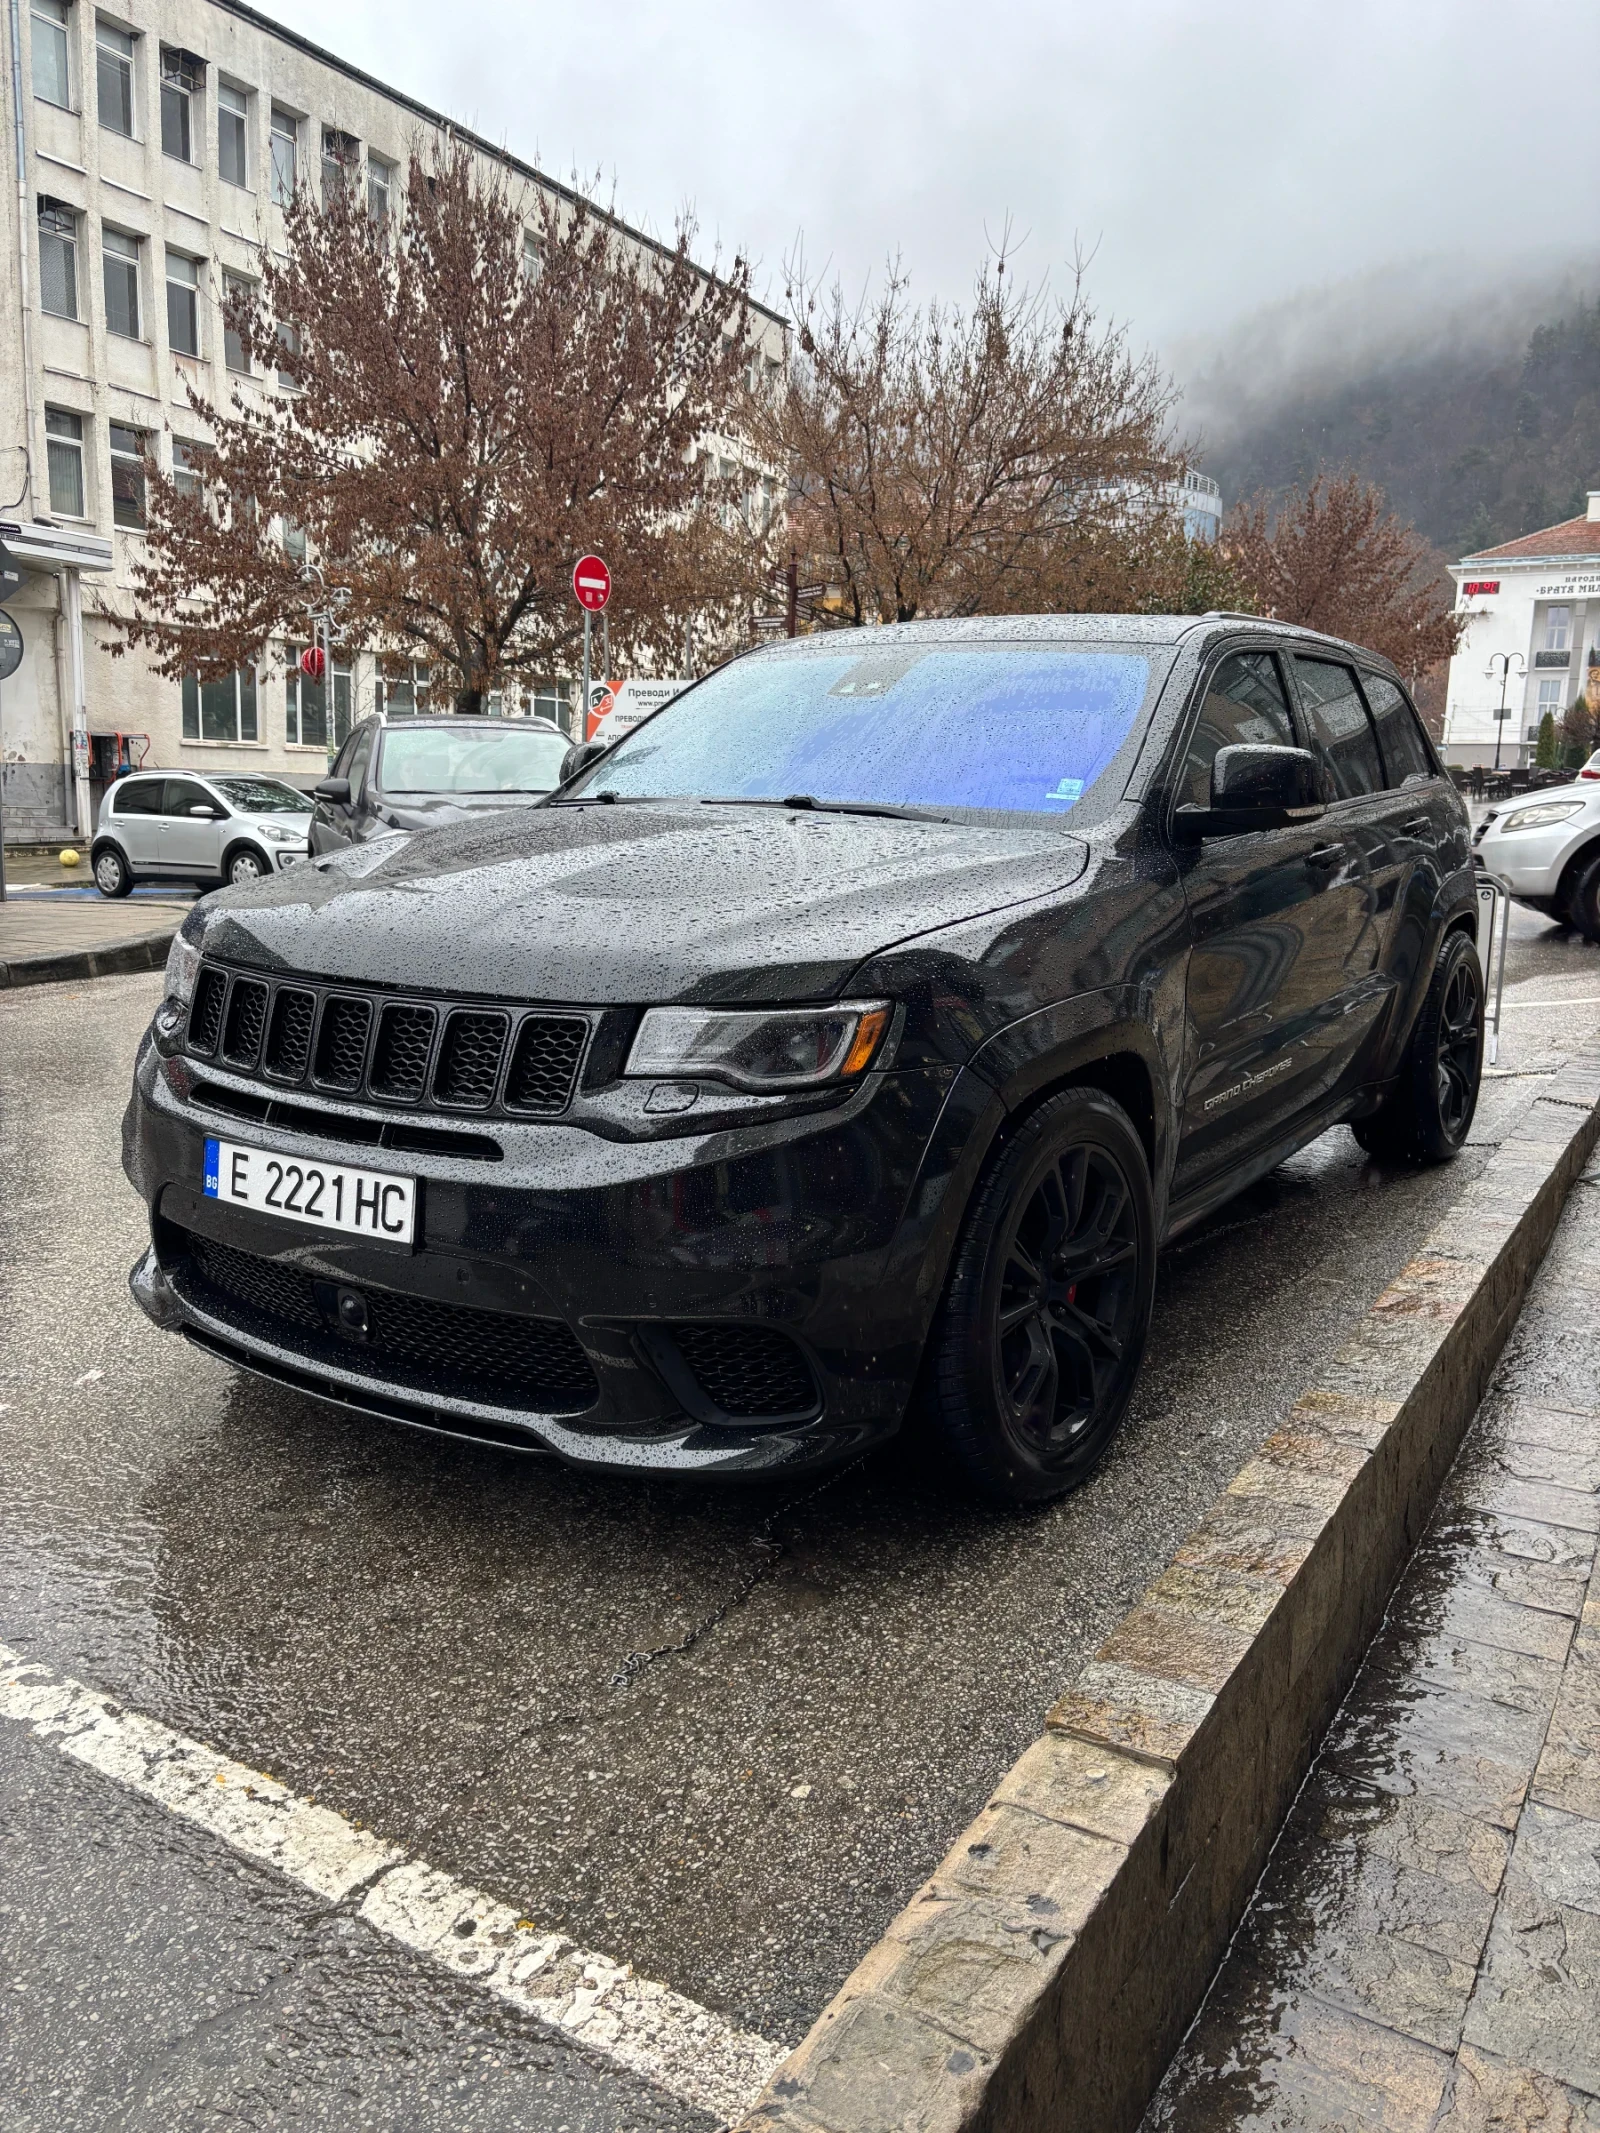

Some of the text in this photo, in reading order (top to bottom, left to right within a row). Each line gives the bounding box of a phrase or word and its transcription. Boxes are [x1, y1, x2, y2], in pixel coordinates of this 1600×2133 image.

[1468, 583, 1479, 594] 10
[628, 689, 670, 698] Преводи
[1203, 1056, 1293, 1111] GRAND CHEROKEE
[206, 1173, 219, 1190] BG
[231, 1151, 406, 1233] E 2221 HC
